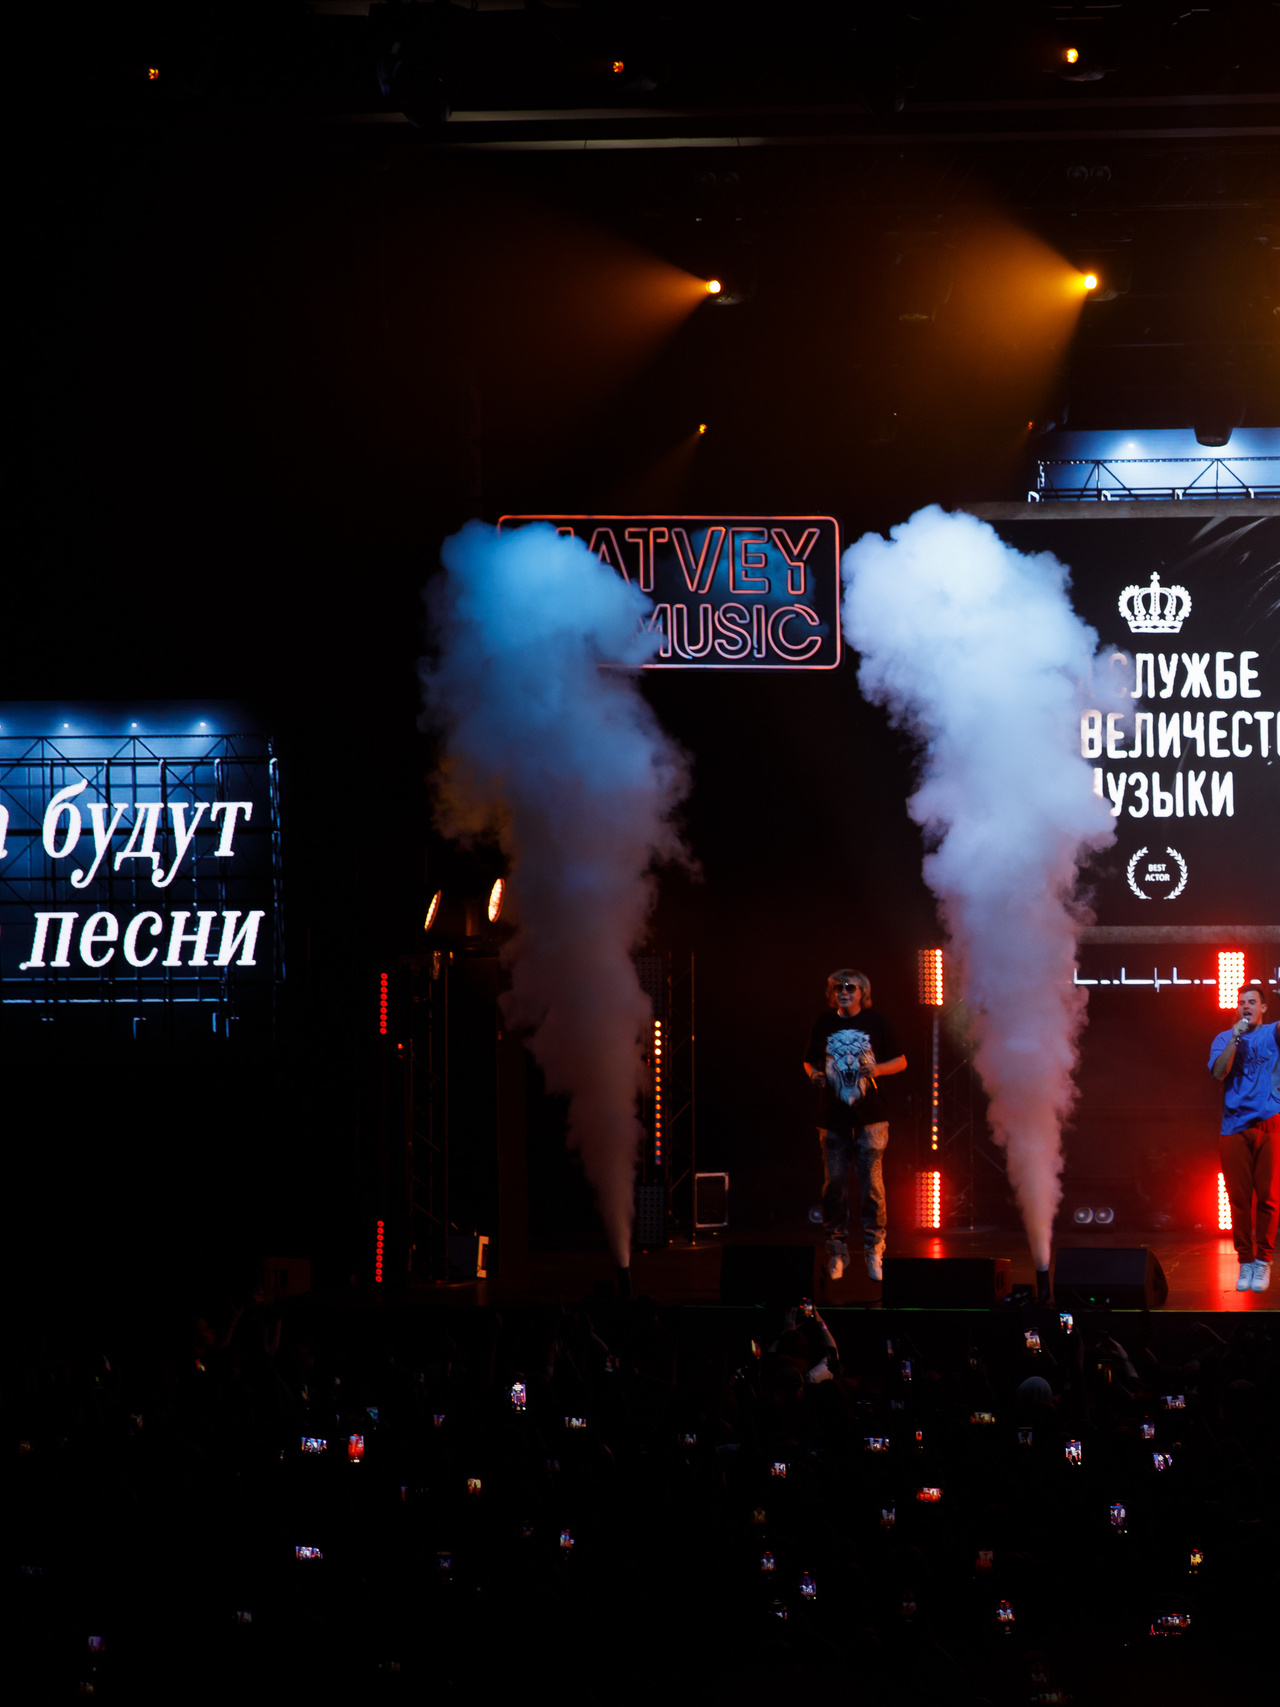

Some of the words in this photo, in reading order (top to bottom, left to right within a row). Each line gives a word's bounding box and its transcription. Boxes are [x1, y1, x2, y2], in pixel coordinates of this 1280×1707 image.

[555, 526, 821, 595] ATVEY
[42, 778, 254, 888] будут
[1144, 873, 1170, 882] ACTOR
[1147, 863, 1166, 872] BEST
[19, 910, 265, 968] песни
